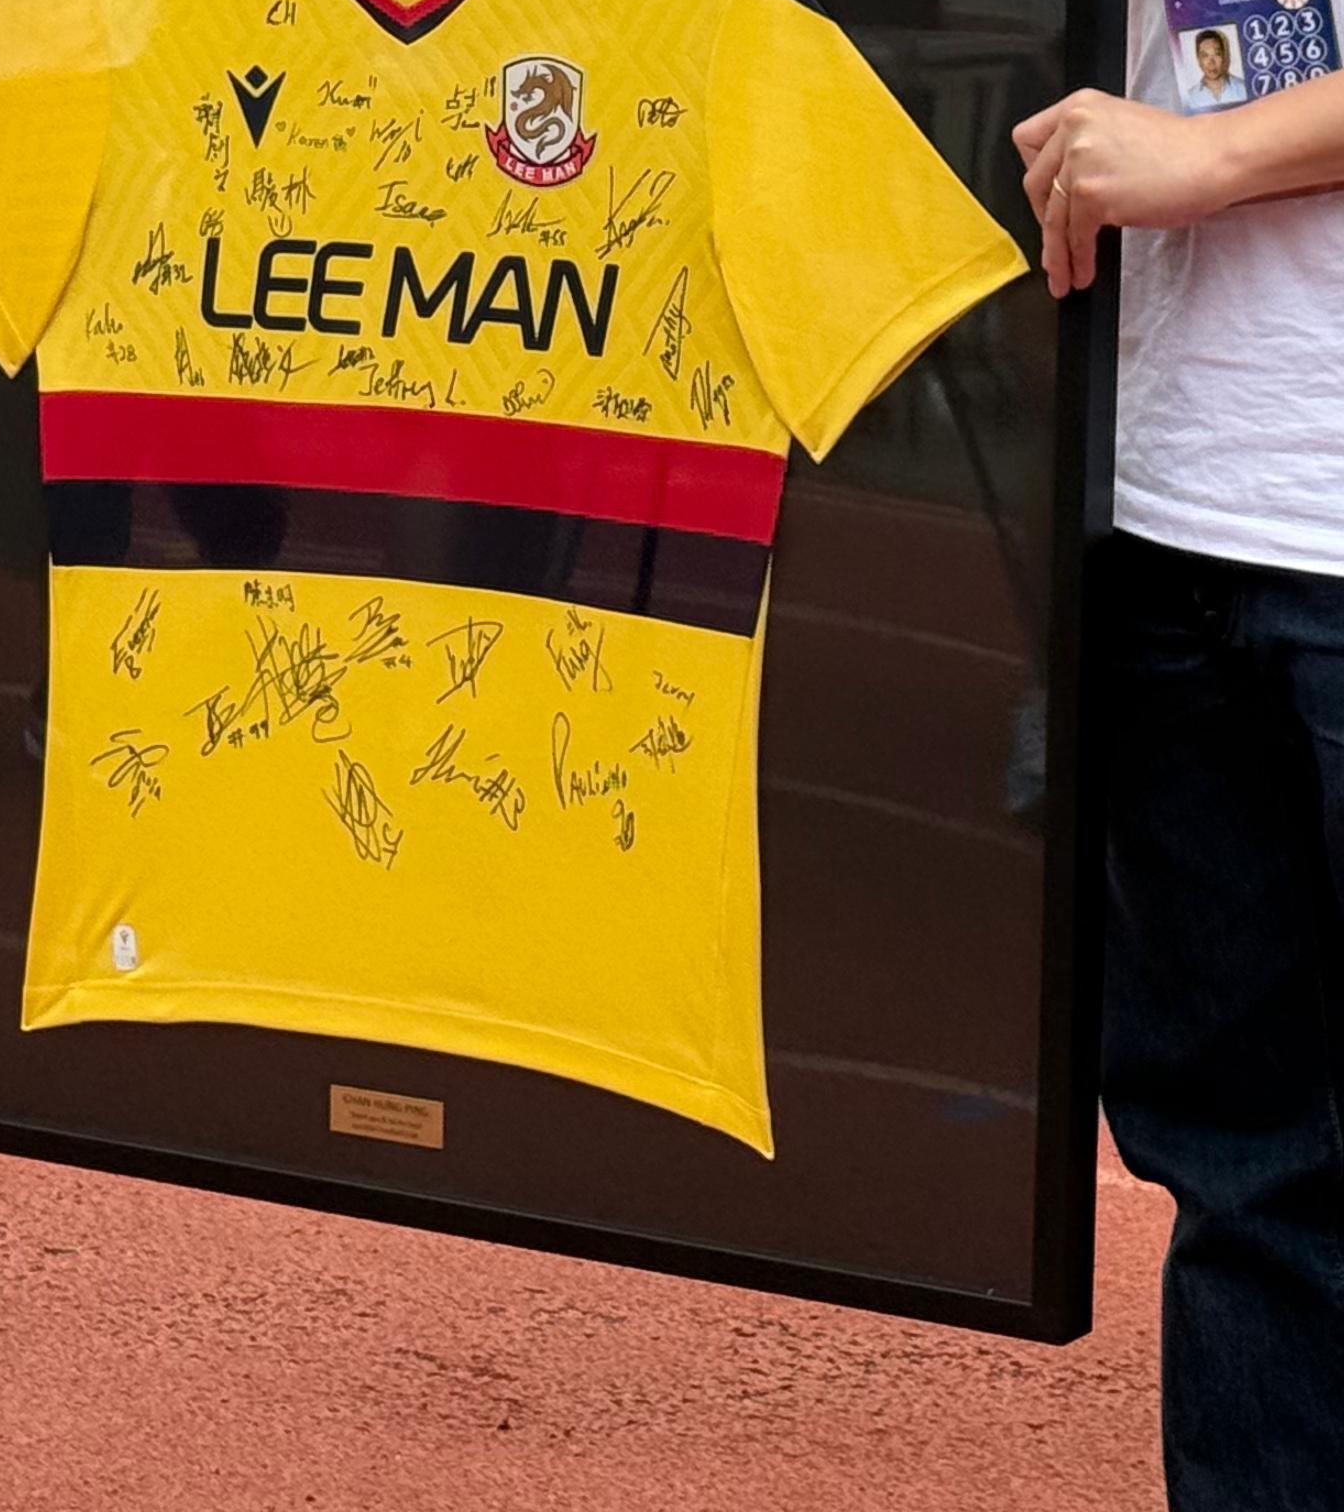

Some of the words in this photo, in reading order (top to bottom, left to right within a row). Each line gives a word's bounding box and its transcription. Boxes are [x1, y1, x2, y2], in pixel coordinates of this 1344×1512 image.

[1250, 20, 1265, 40] 1
[1275, 16, 1291, 36] 2
[1301, 12, 1317, 31] 3
[1254, 47, 1269, 67] 4
[1279, 43, 1295, 63] 5
[1305, 40, 1322, 59] 6
[1258, 75, 1271, 95] 7
[505, 157, 536, 180] LEE
[542, 162, 577, 183] MAN
[201, 237, 374, 336] LEE
[382, 246, 620, 357] MAN
